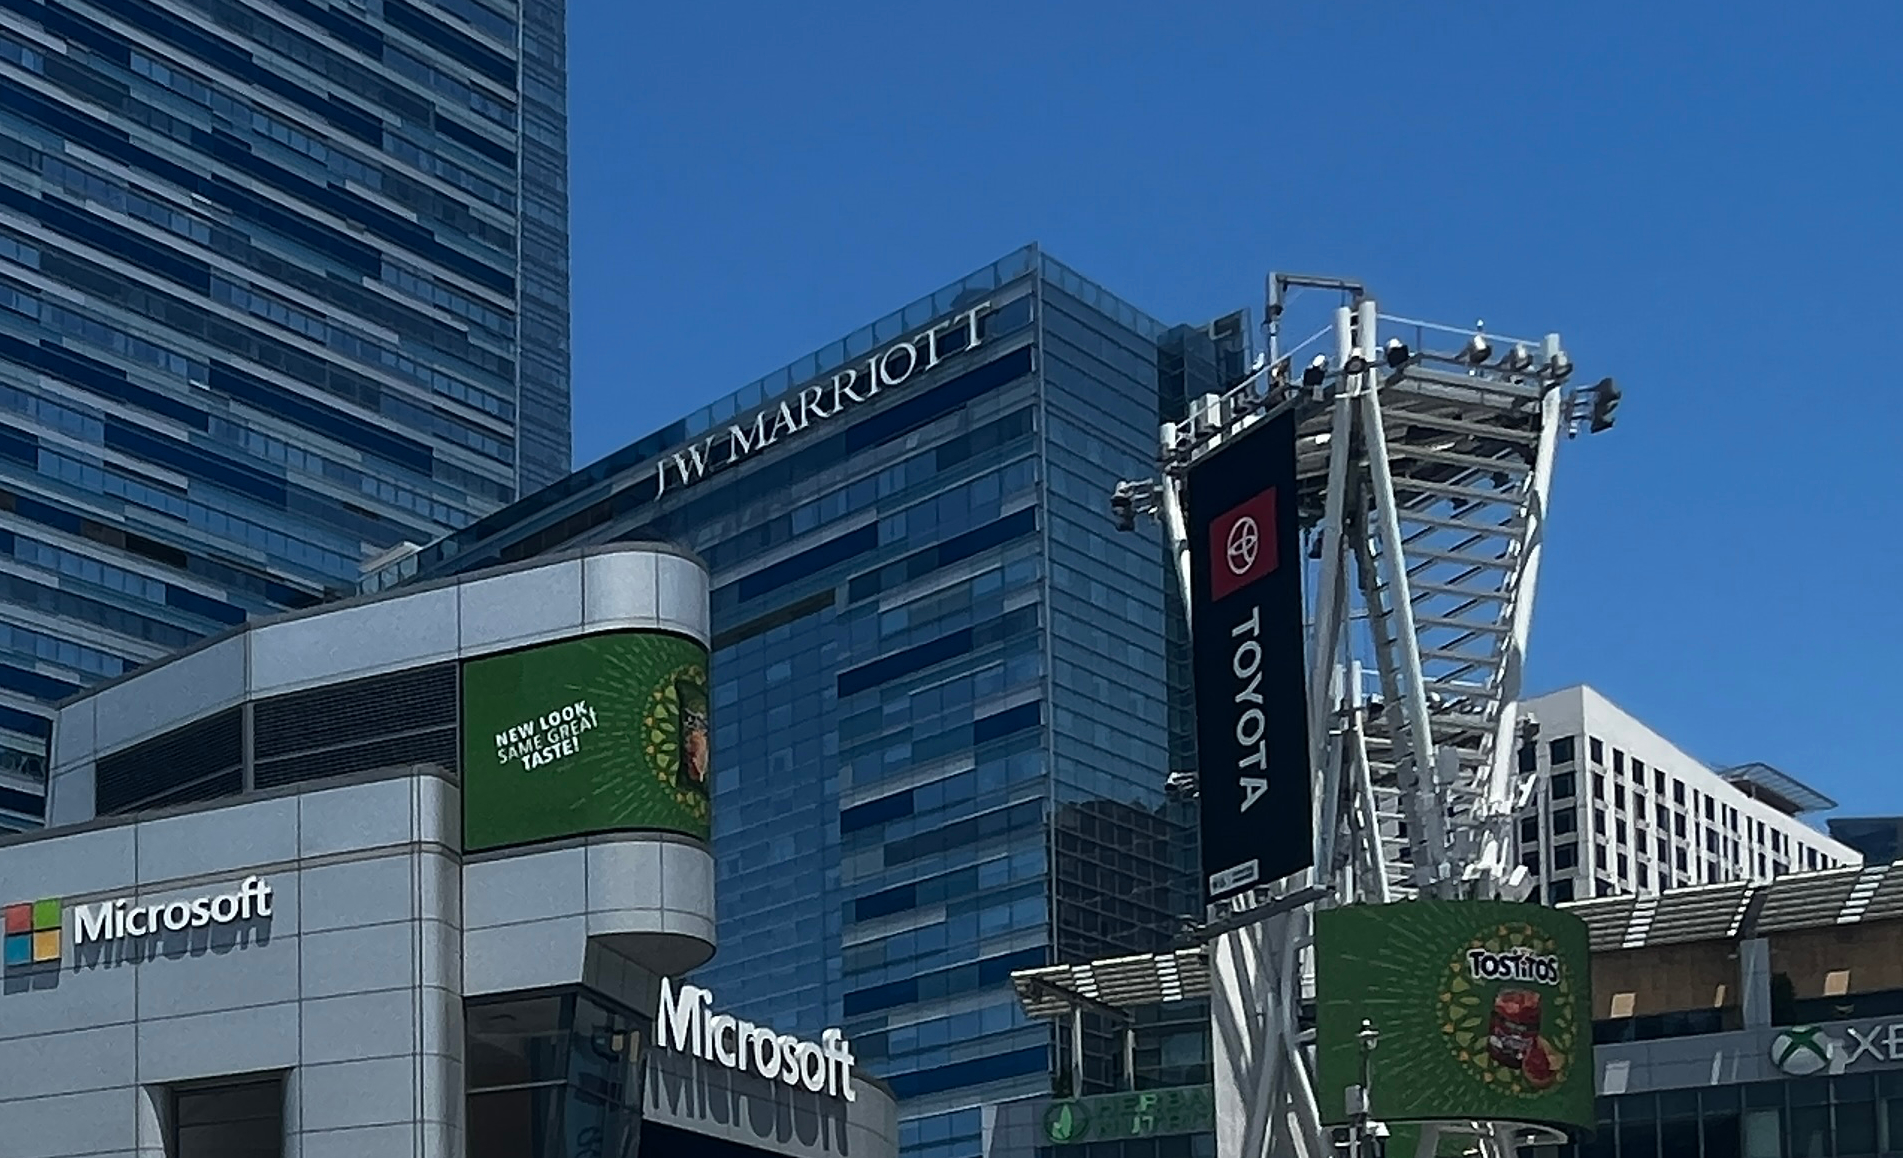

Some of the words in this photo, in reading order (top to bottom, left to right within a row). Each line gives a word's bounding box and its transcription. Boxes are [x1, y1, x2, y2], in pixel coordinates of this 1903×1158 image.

[654, 434, 715, 501] JW
[725, 301, 991, 464] MARRIOTT
[495, 721, 534, 748] NEW
[497, 736, 543, 764] SAME
[547, 706, 598, 744] GREAT
[1231, 605, 1268, 813] TOYOTA
[521, 736, 580, 771] TASTE!
[73, 875, 274, 944] Microsoft
[657, 976, 856, 1102] Microsoft
